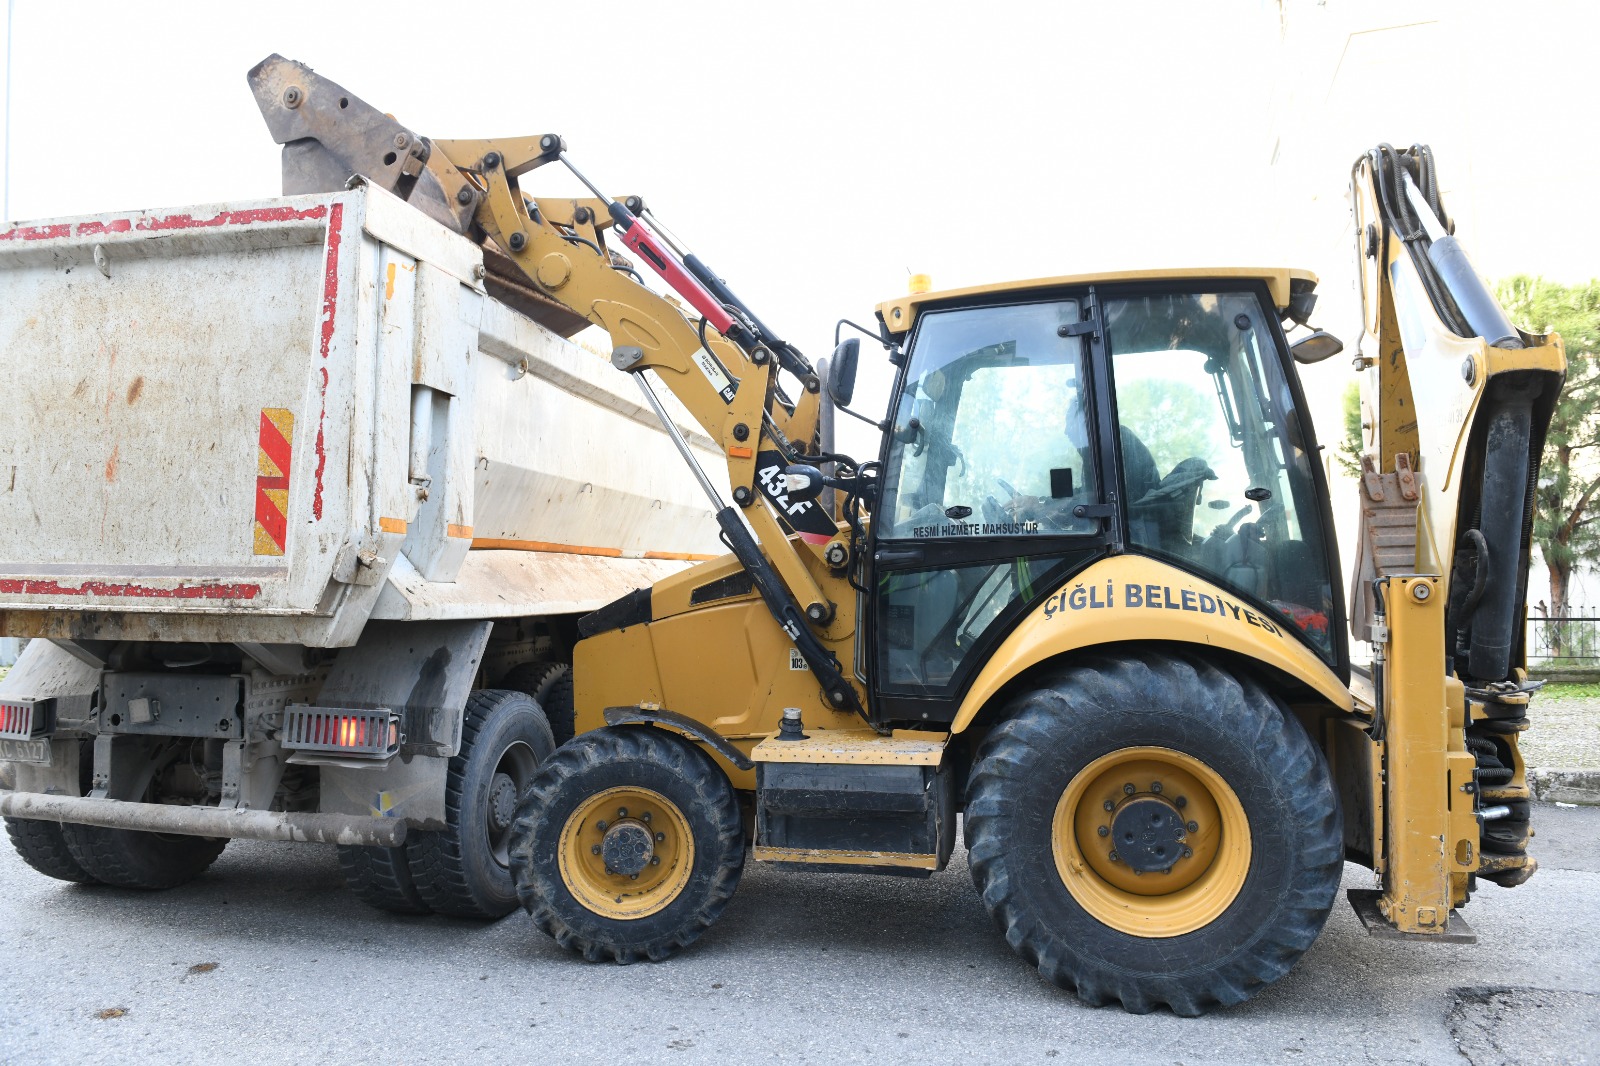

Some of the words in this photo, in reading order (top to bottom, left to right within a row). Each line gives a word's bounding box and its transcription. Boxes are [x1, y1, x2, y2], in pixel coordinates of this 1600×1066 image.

[913, 523, 939, 538] RESMİ
[941, 522, 980, 536] HİZMETE
[1043, 578, 1114, 620] ÇİĞLİ
[792, 658, 802, 669] 103
[15, 740, 44, 760] 6127
